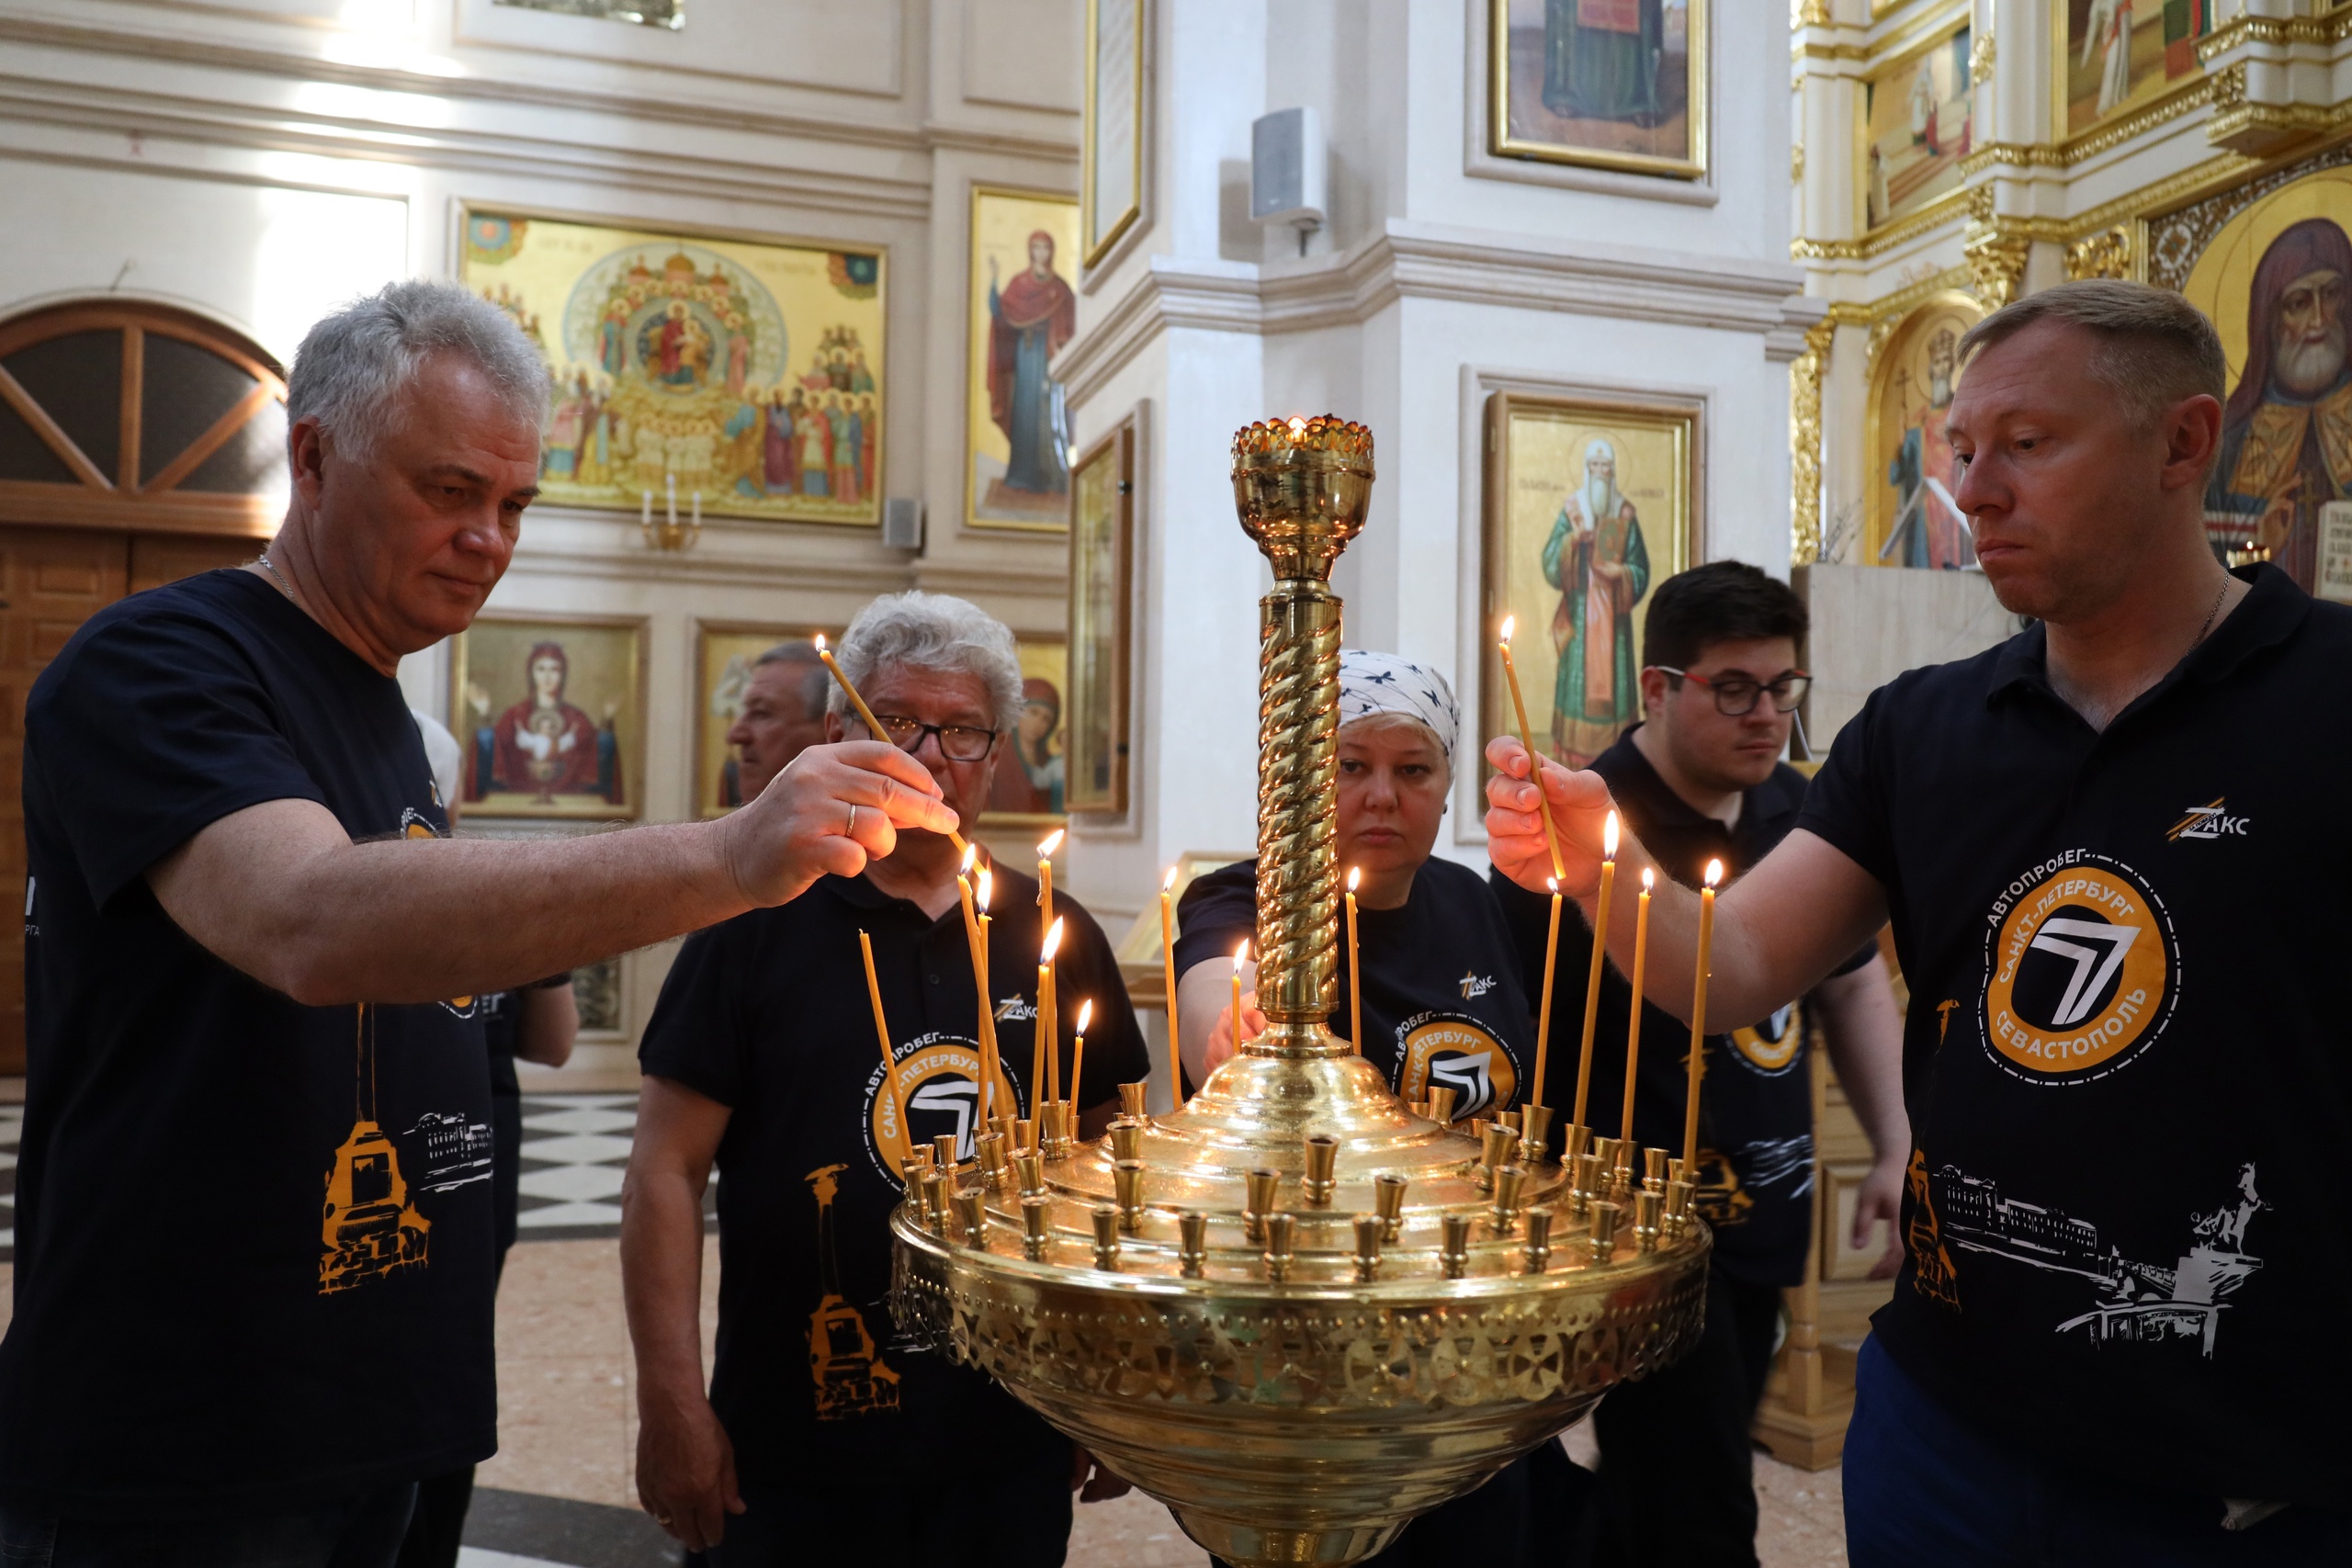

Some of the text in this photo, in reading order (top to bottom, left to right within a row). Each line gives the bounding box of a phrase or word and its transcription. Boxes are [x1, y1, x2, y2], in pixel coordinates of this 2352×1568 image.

[1987, 848, 2086, 928] АВТОПРОБЕГ
[1999, 879, 2135, 983] САНКТ-ПЕТЕРБУРГ
[1996, 988, 2146, 1059] СЕВАСТОПОЛЬ
